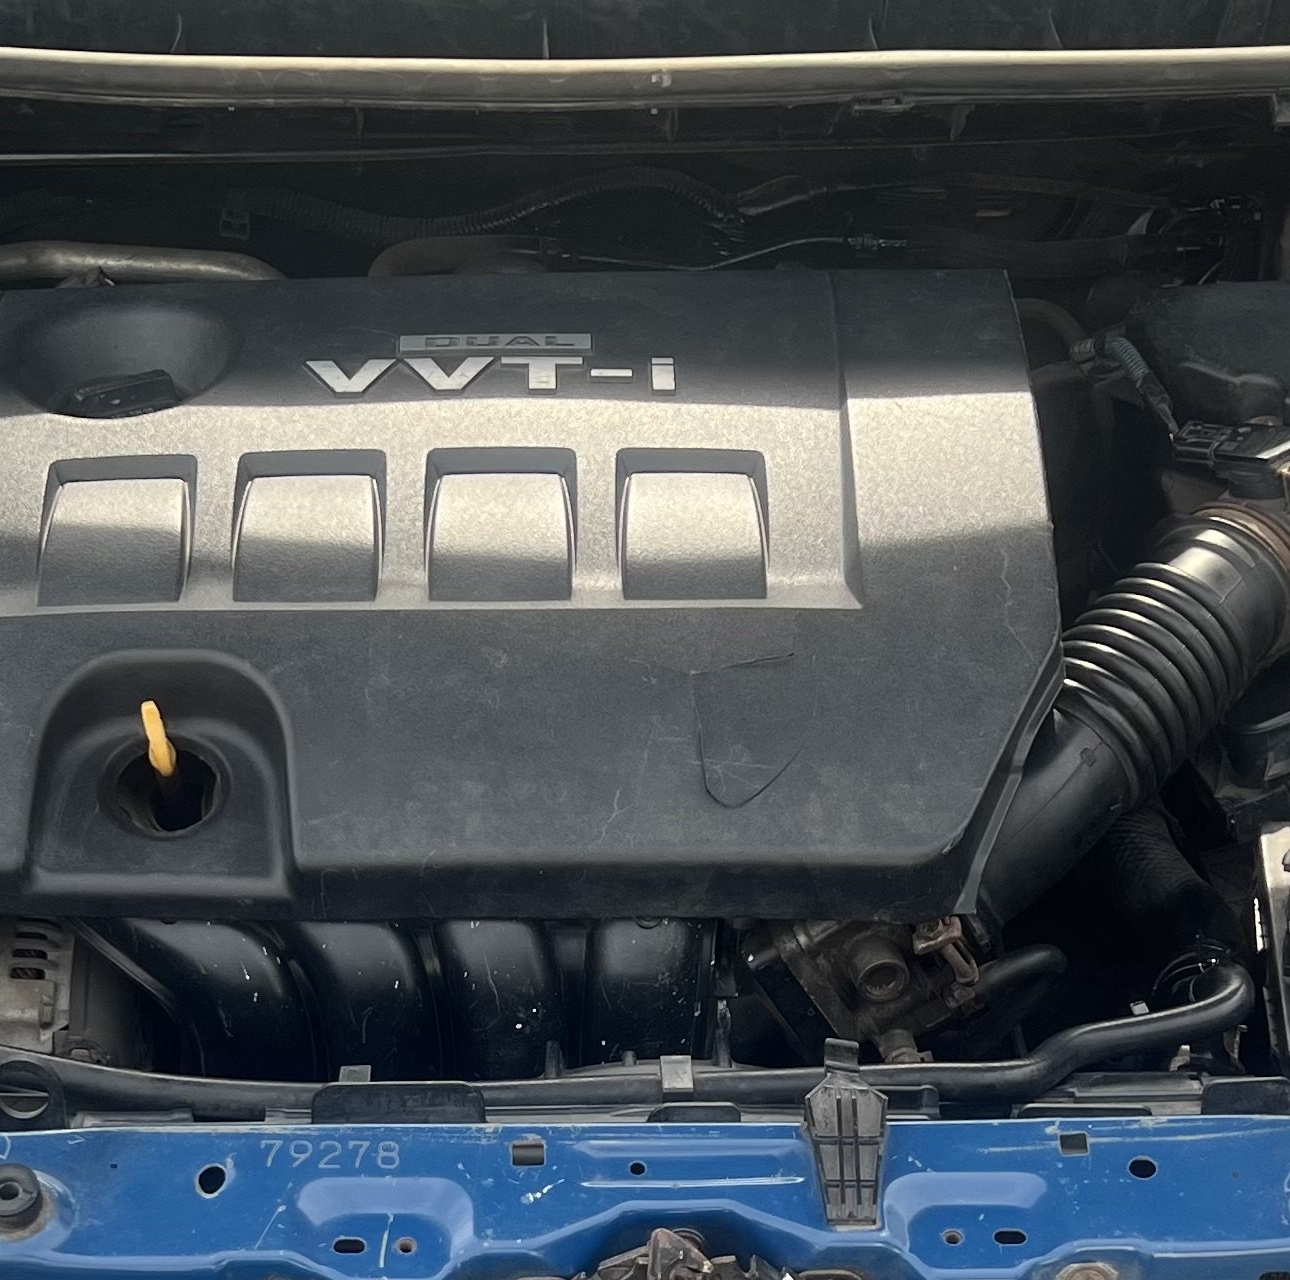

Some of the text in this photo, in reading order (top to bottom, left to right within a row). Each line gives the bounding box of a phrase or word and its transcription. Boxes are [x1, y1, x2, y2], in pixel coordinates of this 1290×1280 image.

[424, 335, 575, 347] DUAL
[304, 356, 677, 394] VVT-i
[259, 1139, 401, 1170] 79278
